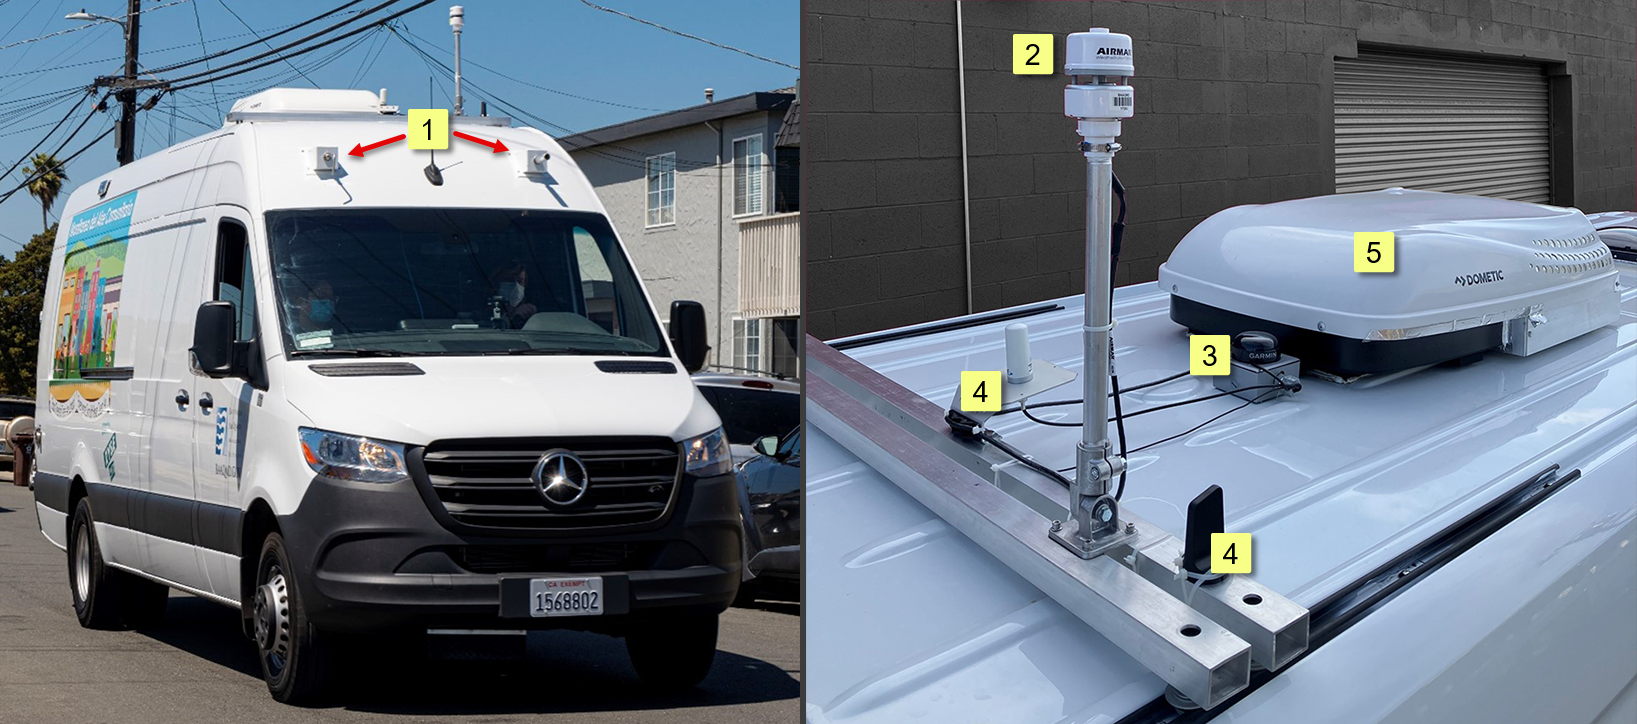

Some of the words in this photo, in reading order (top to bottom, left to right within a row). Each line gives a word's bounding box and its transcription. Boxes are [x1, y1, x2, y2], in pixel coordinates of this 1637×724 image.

[1466, 269, 1504, 286] DOMETIC
[1248, 351, 1277, 360] GARMIN
[561, 580, 585, 588] EXEMPT
[535, 590, 599, 612] 1568802
